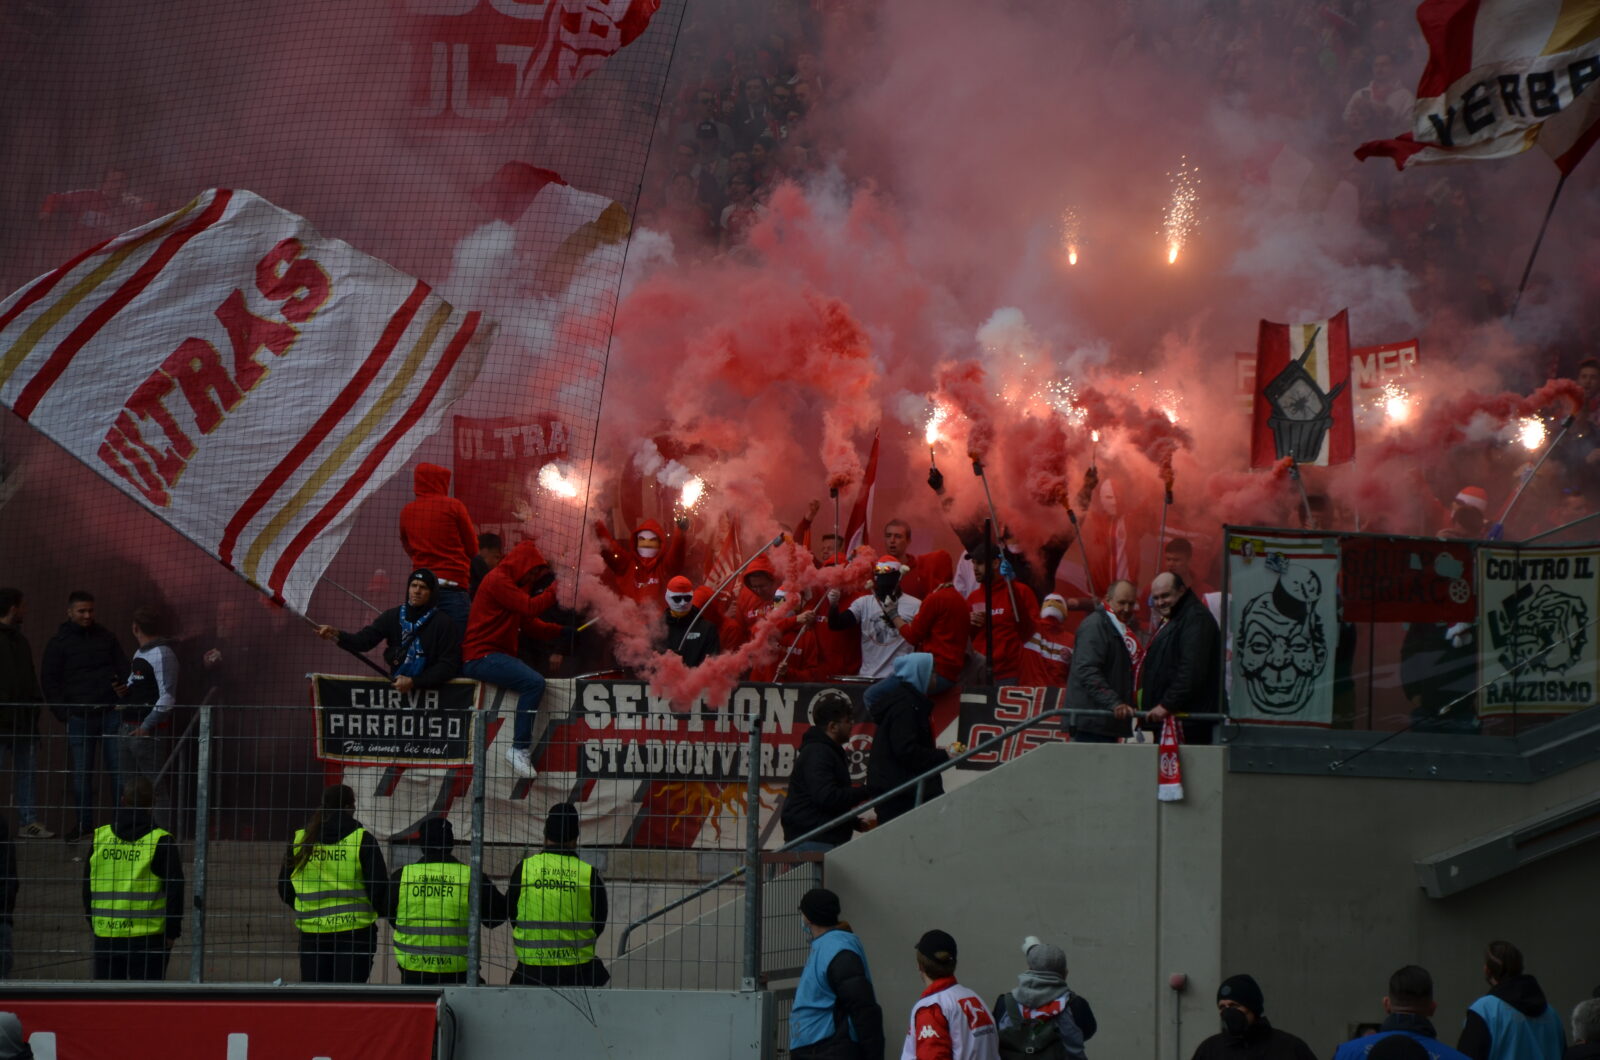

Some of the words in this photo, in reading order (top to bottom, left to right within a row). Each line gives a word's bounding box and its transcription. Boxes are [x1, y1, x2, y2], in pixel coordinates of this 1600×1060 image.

[97, 238, 334, 507] ULTRAS
[1486, 558, 1570, 581] CONTRO
[1574, 558, 1594, 579] IL
[352, 688, 439, 710] CURVA
[1486, 682, 1592, 706] RAZZISMO
[367, 743, 401, 755] immer
[585, 738, 800, 778] STADIONVERB
[102, 848, 141, 862] ORDNER
[309, 849, 347, 862] ORDNER
[412, 885, 454, 898] ORDNER
[534, 879, 577, 893] ORDNER
[326, 915, 357, 926] MEWA
[547, 948, 577, 959] MEWA
[422, 957, 452, 966] MEWA
